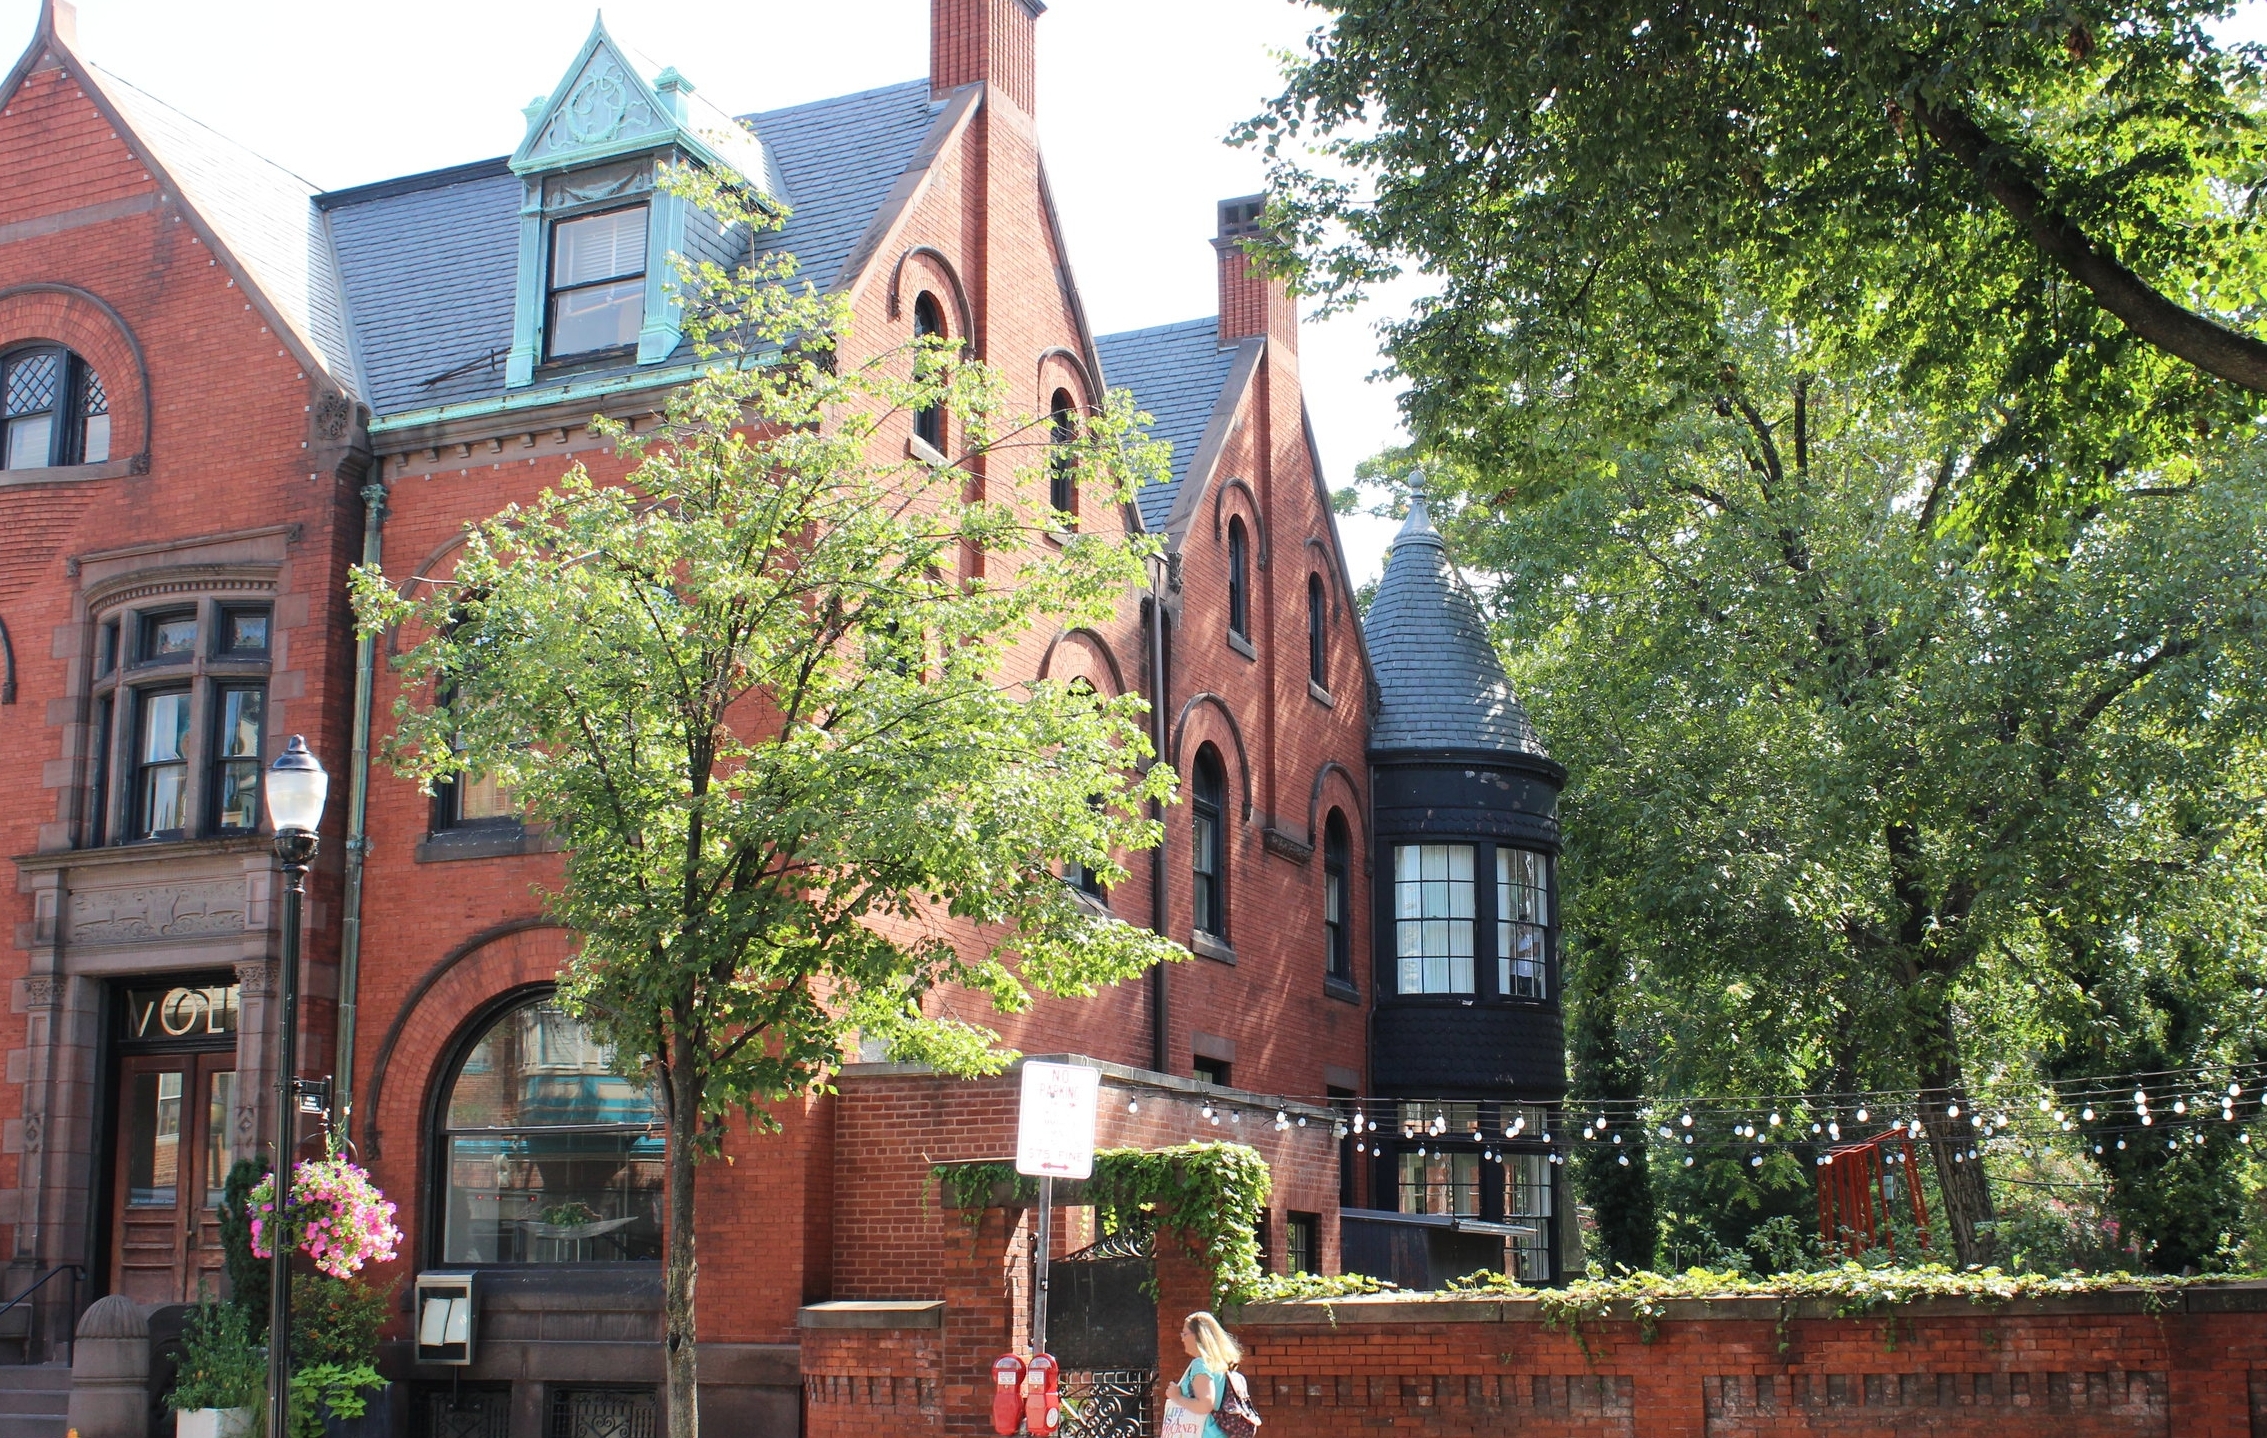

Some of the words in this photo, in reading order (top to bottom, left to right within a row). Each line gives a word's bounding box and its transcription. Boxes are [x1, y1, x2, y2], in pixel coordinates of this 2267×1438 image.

[126, 984, 239, 1037] VOL
[1052, 1069, 1069, 1083] NO
[1039, 1083, 1080, 1100] PARKING
[1058, 1150, 1083, 1162] FINE
[1166, 1407, 1186, 1417] LIFE
[1162, 1423, 1199, 1434] JOURNEY
